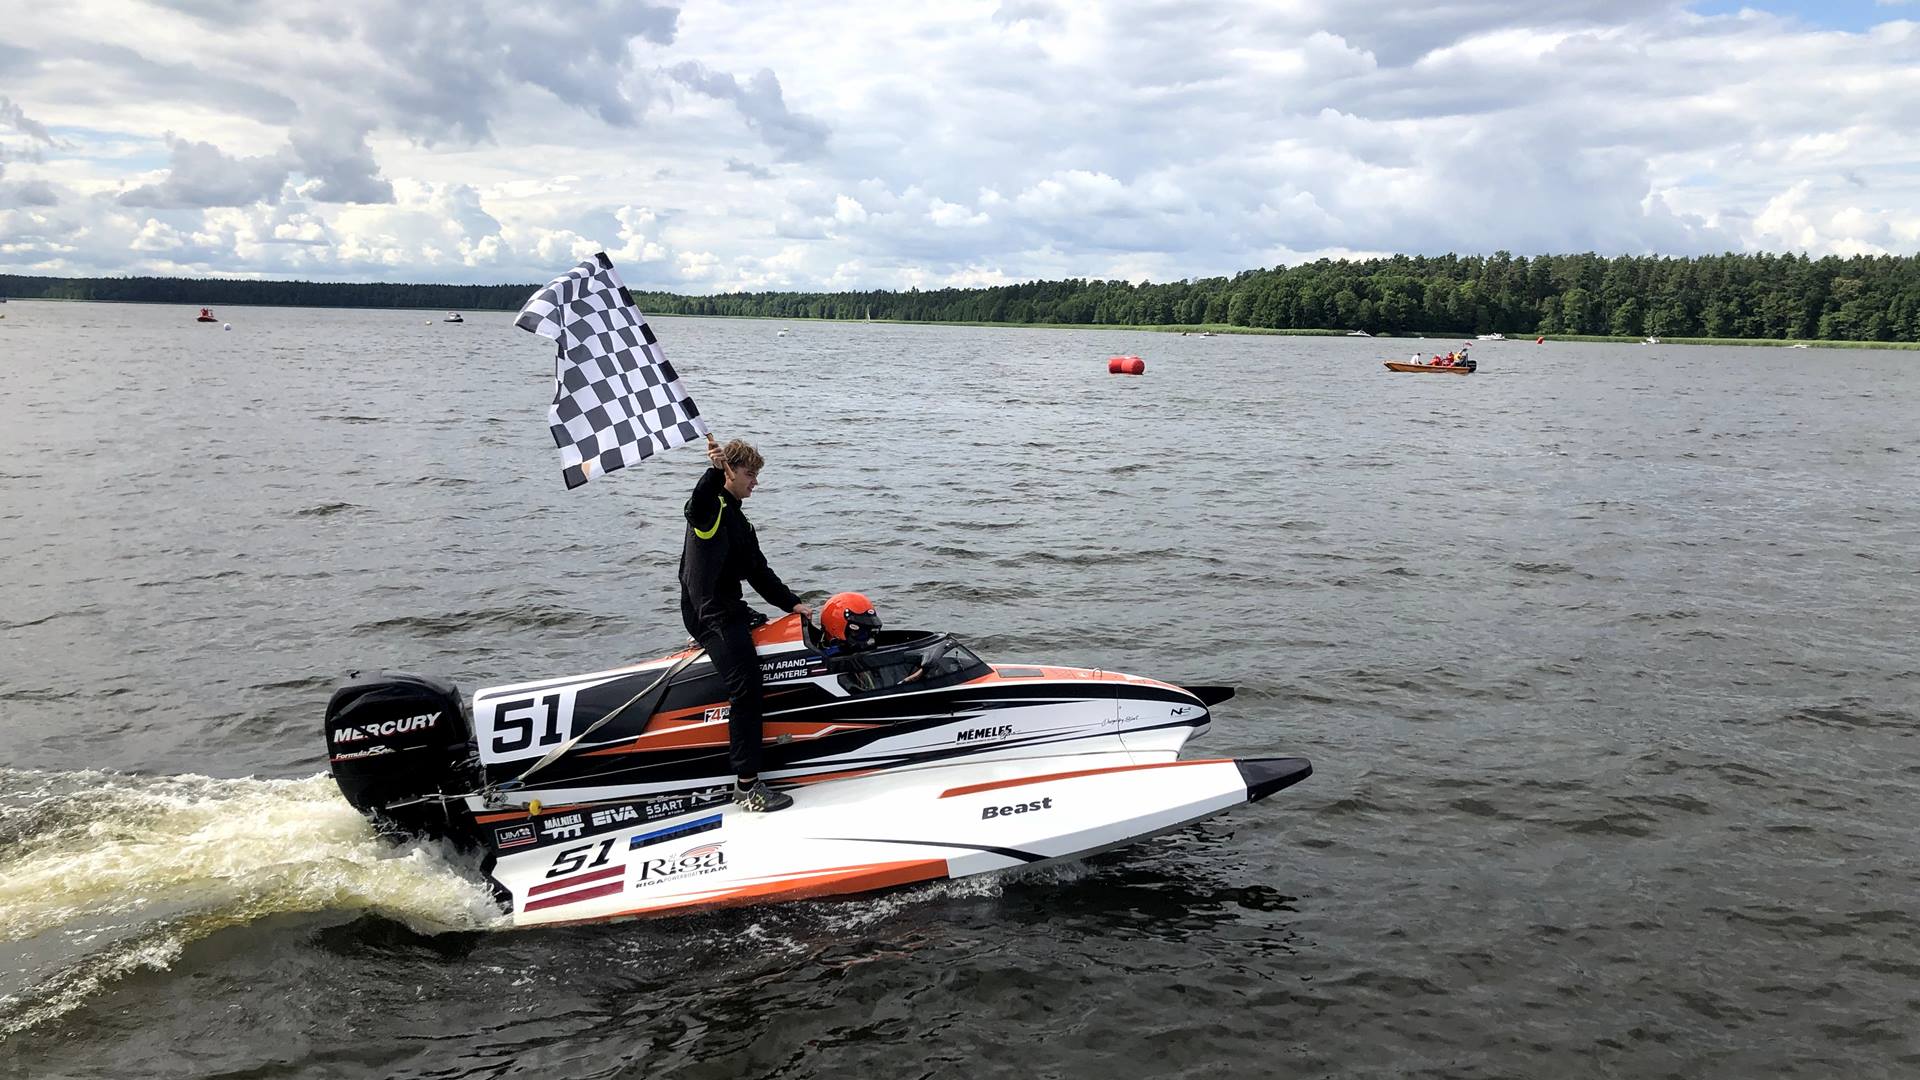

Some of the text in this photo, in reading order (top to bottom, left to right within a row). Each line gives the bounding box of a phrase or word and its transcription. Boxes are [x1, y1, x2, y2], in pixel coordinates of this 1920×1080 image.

[763, 668, 808, 681] SLAKTERIS
[776, 658, 806, 670] ARAND
[492, 693, 562, 754] 51
[705, 708, 721, 722] F4
[333, 711, 442, 743] MERCURY
[591, 805, 639, 826] EIVA
[981, 797, 1052, 820] Beast
[500, 830, 520, 840] UIM
[546, 838, 616, 878] 51
[637, 850, 729, 882] Riga
